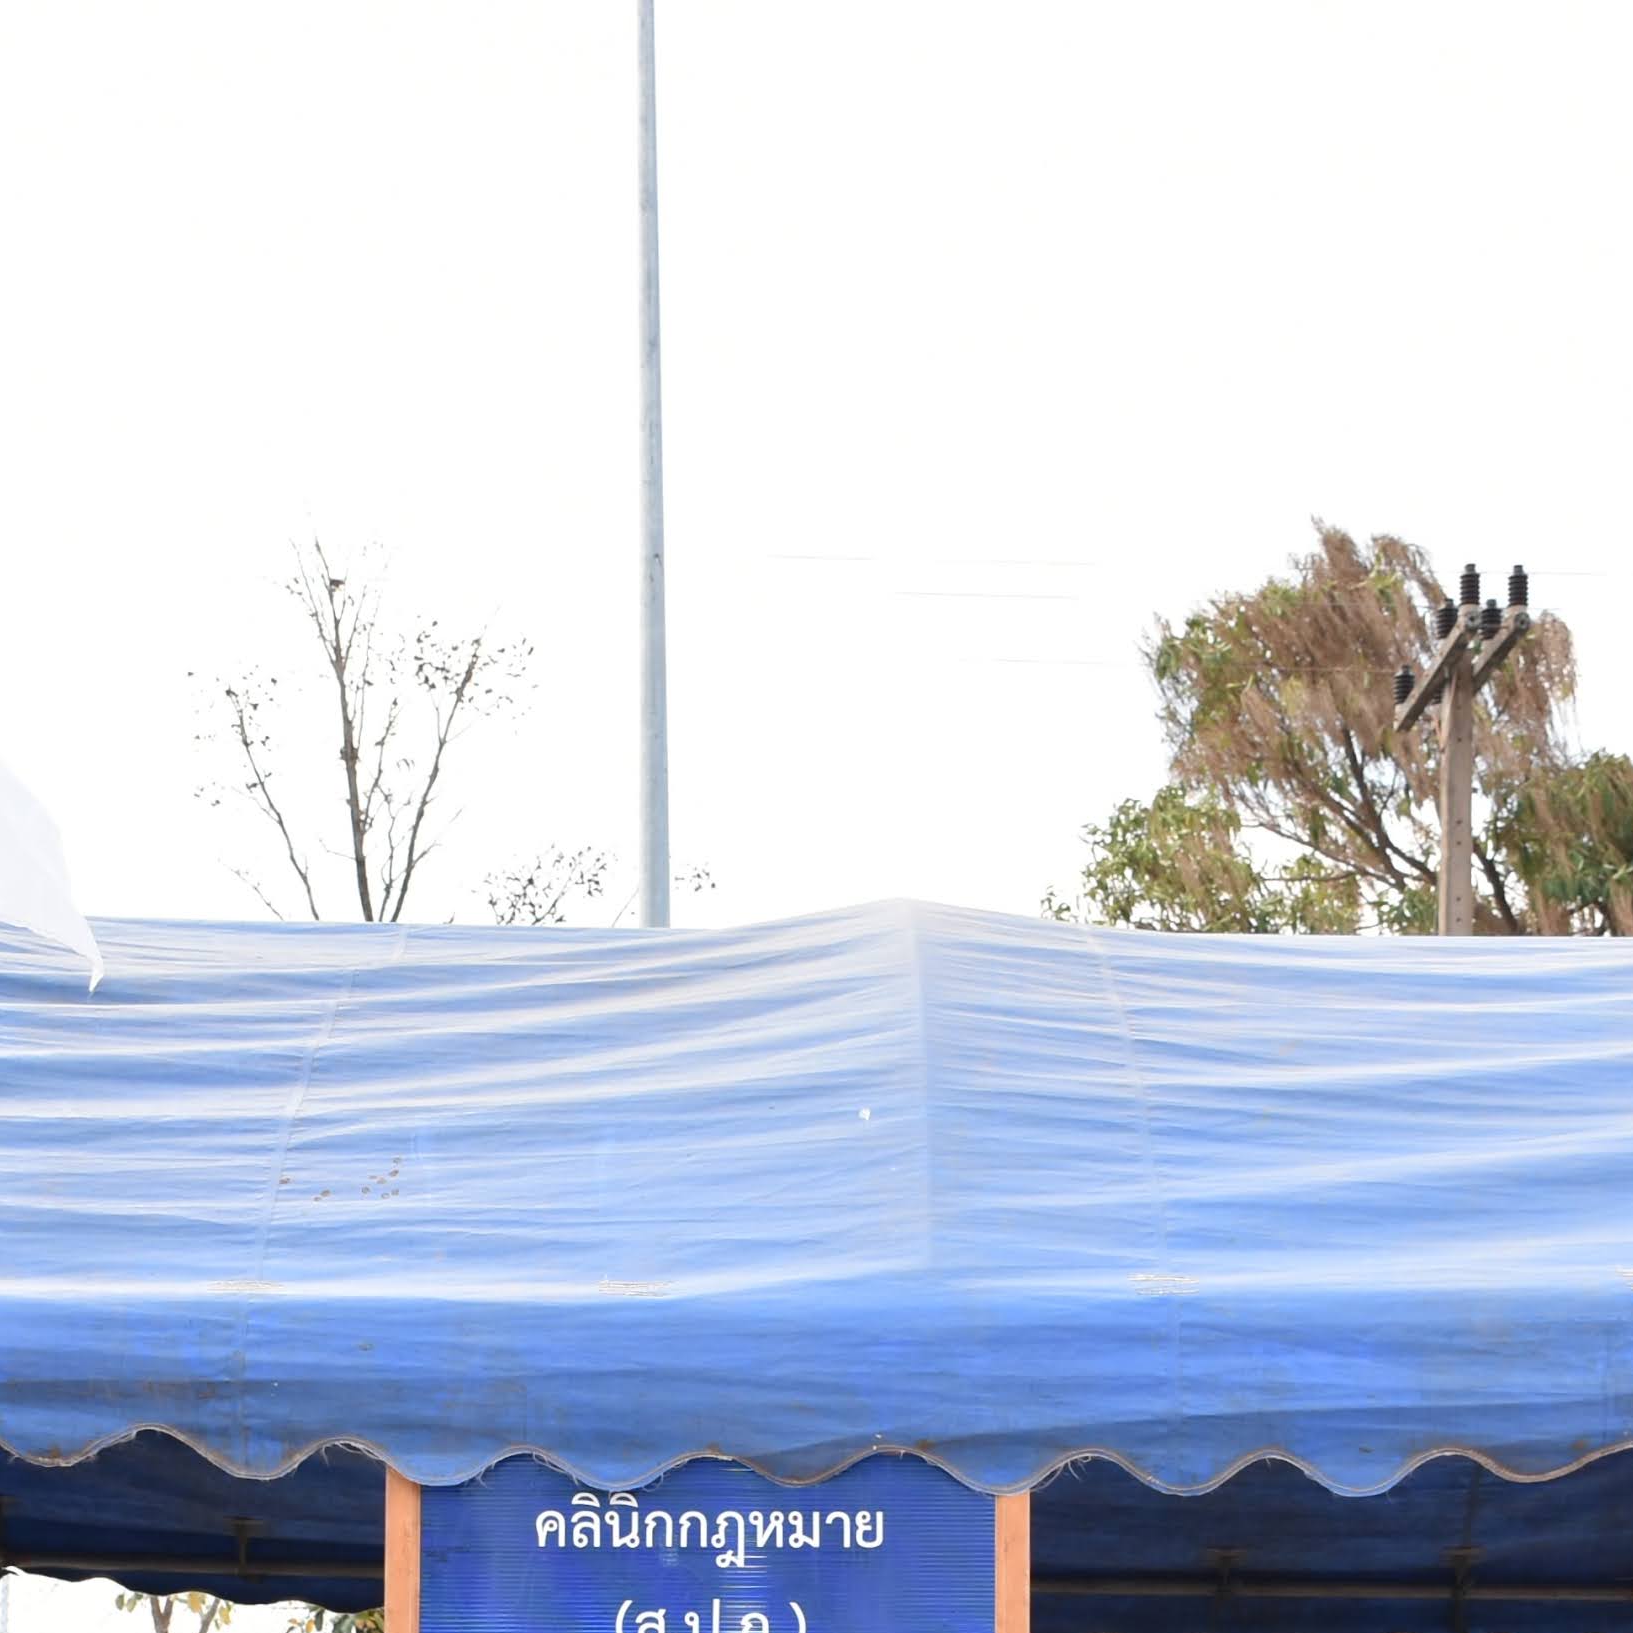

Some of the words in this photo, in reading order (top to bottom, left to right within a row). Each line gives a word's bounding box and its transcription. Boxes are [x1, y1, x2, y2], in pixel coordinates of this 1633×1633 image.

[535, 1493, 884, 1568] คลินิกกฎหมาย
